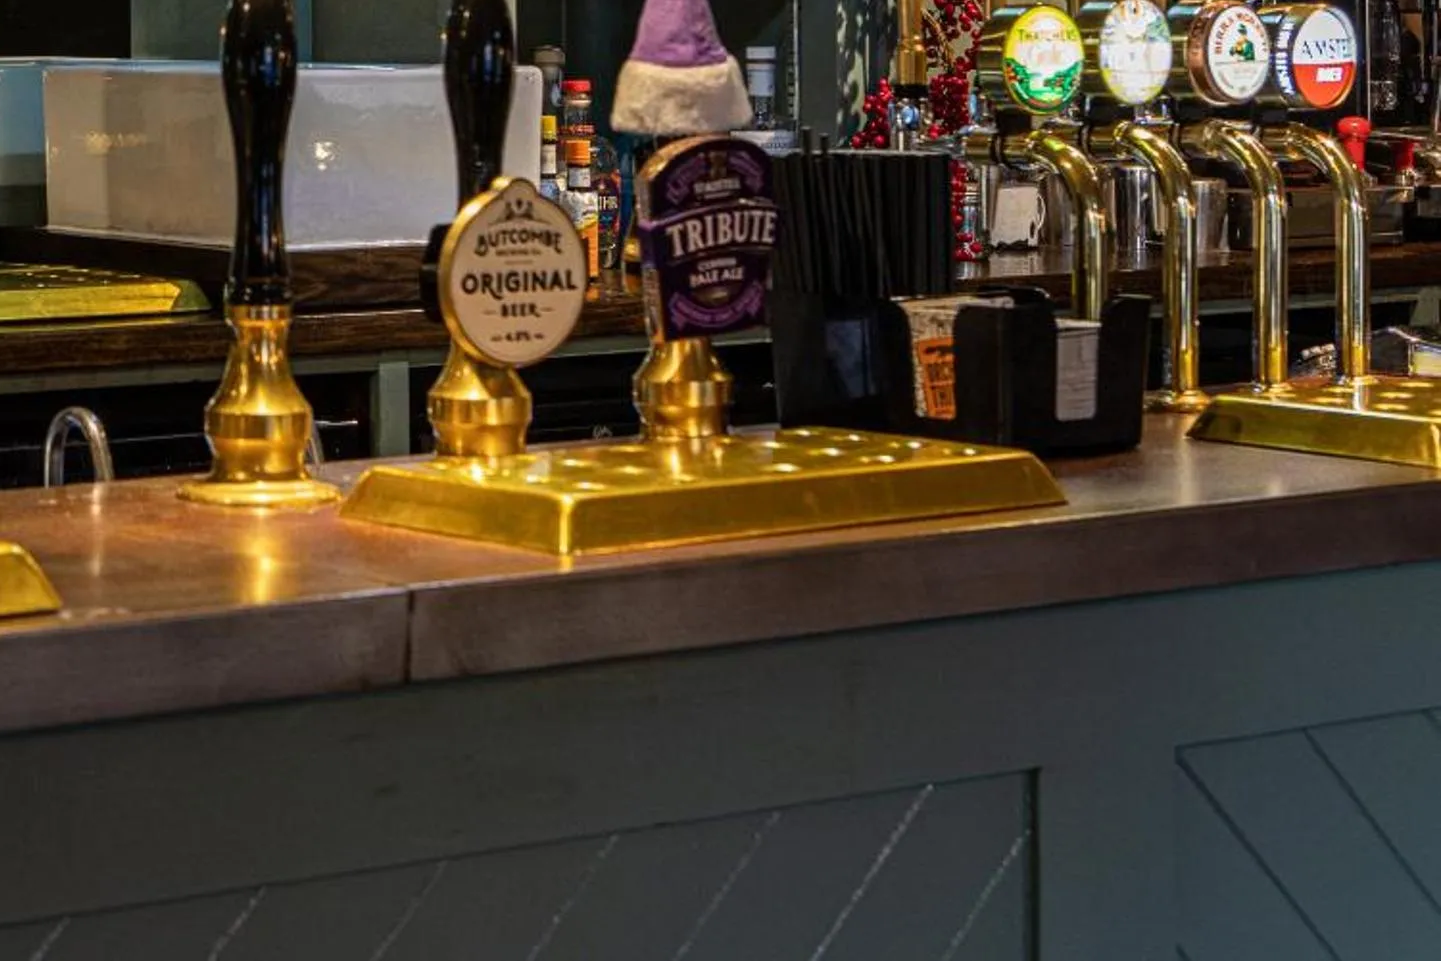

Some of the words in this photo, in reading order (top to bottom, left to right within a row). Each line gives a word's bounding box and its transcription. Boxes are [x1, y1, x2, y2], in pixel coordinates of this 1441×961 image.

[474, 228, 563, 257] BUTCOMBE
[666, 209, 778, 258] TRIBUTE
[461, 269, 578, 301] ORIGINAL
[721, 266, 745, 282] ALE
[501, 303, 542, 318] BEER
